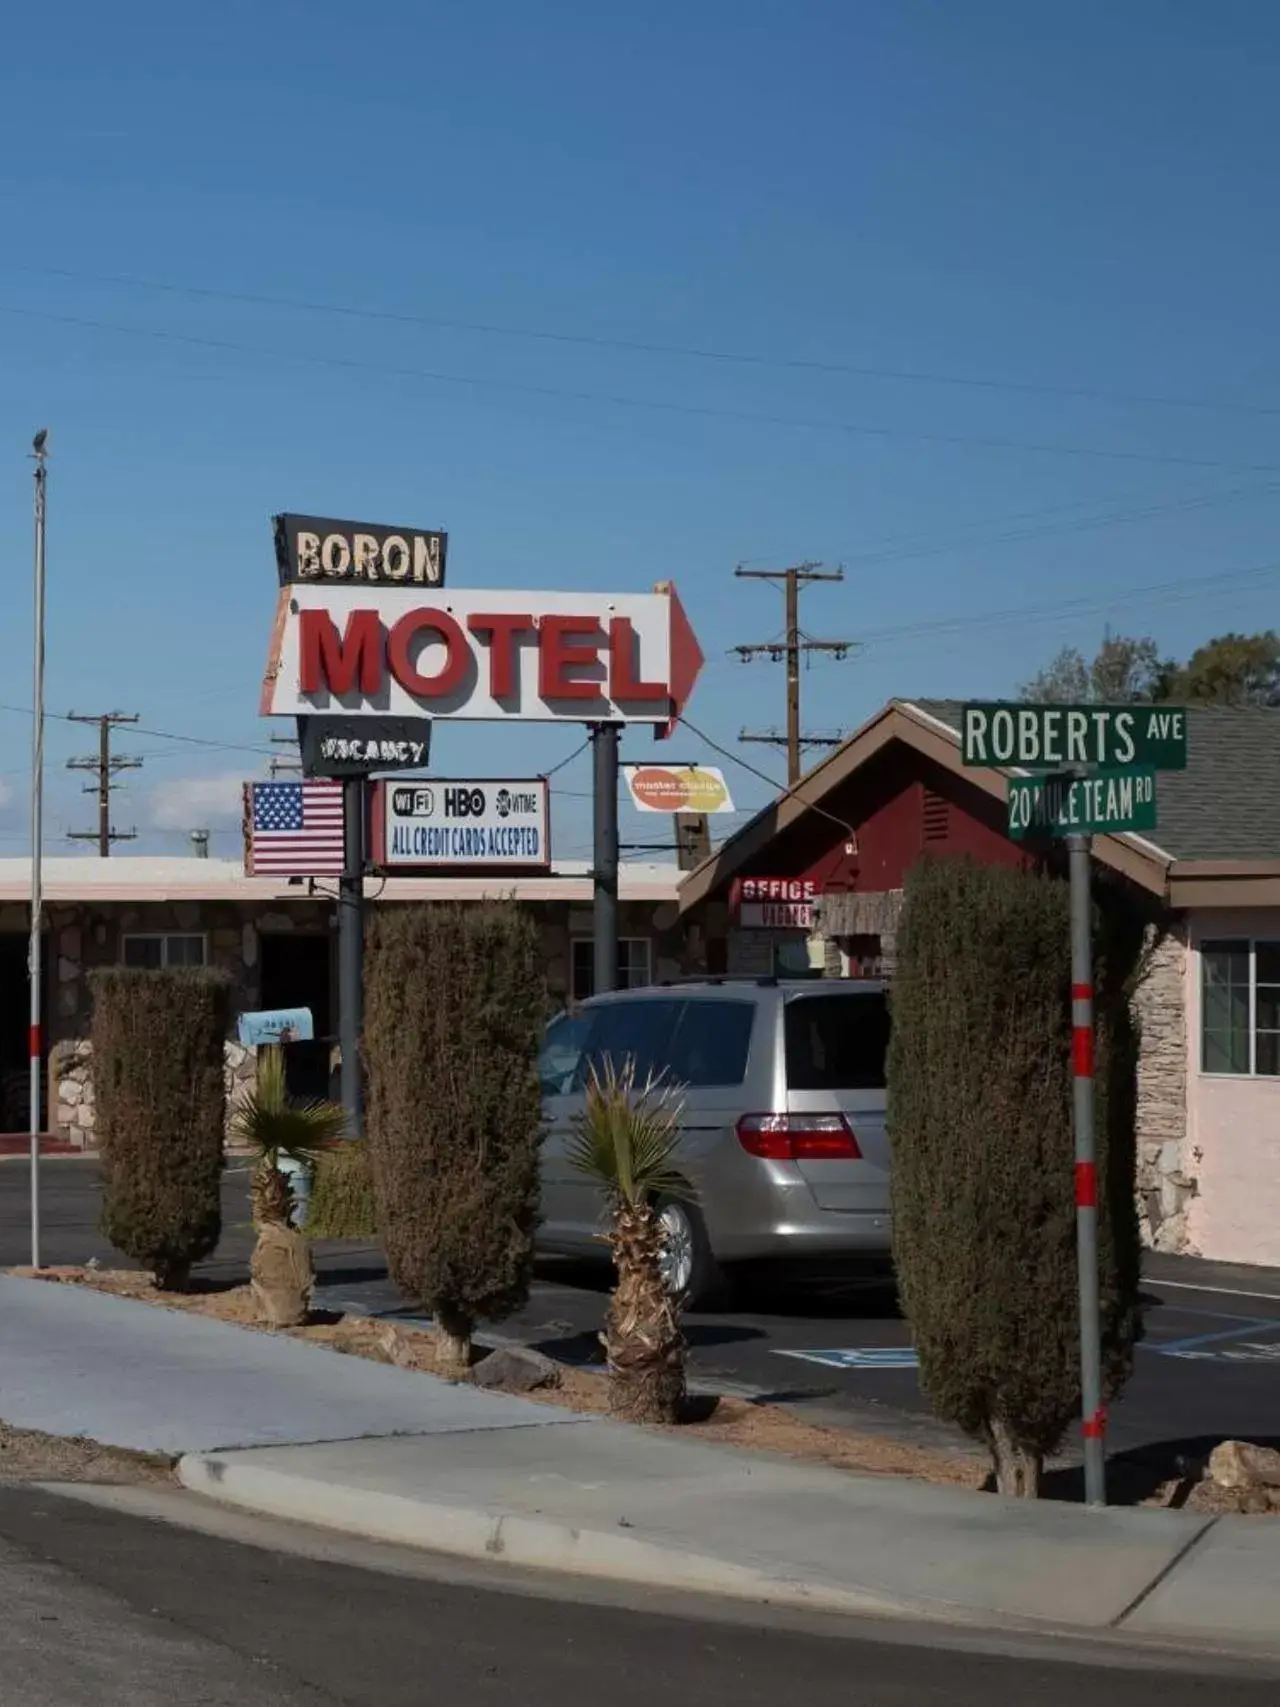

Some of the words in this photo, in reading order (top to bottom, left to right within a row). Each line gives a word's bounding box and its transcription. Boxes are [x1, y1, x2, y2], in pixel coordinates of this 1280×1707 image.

[296, 531, 440, 582] BORON
[299, 607, 669, 700] MOTEL
[320, 738, 425, 763] VACANCY
[967, 709, 1135, 763] ROBERTS
[1147, 713, 1183, 740] AVE
[444, 788, 485, 817] HBO
[1009, 786, 1031, 829] 20
[1084, 776, 1133, 822] TEAM
[1136, 776, 1152, 803] RD
[393, 826, 411, 855] ALL
[414, 826, 450, 856] CREDIT
[452, 827, 486, 856] CARDS
[489, 827, 539, 856] ACCEPTED
[742, 880, 815, 899] OFFICE
